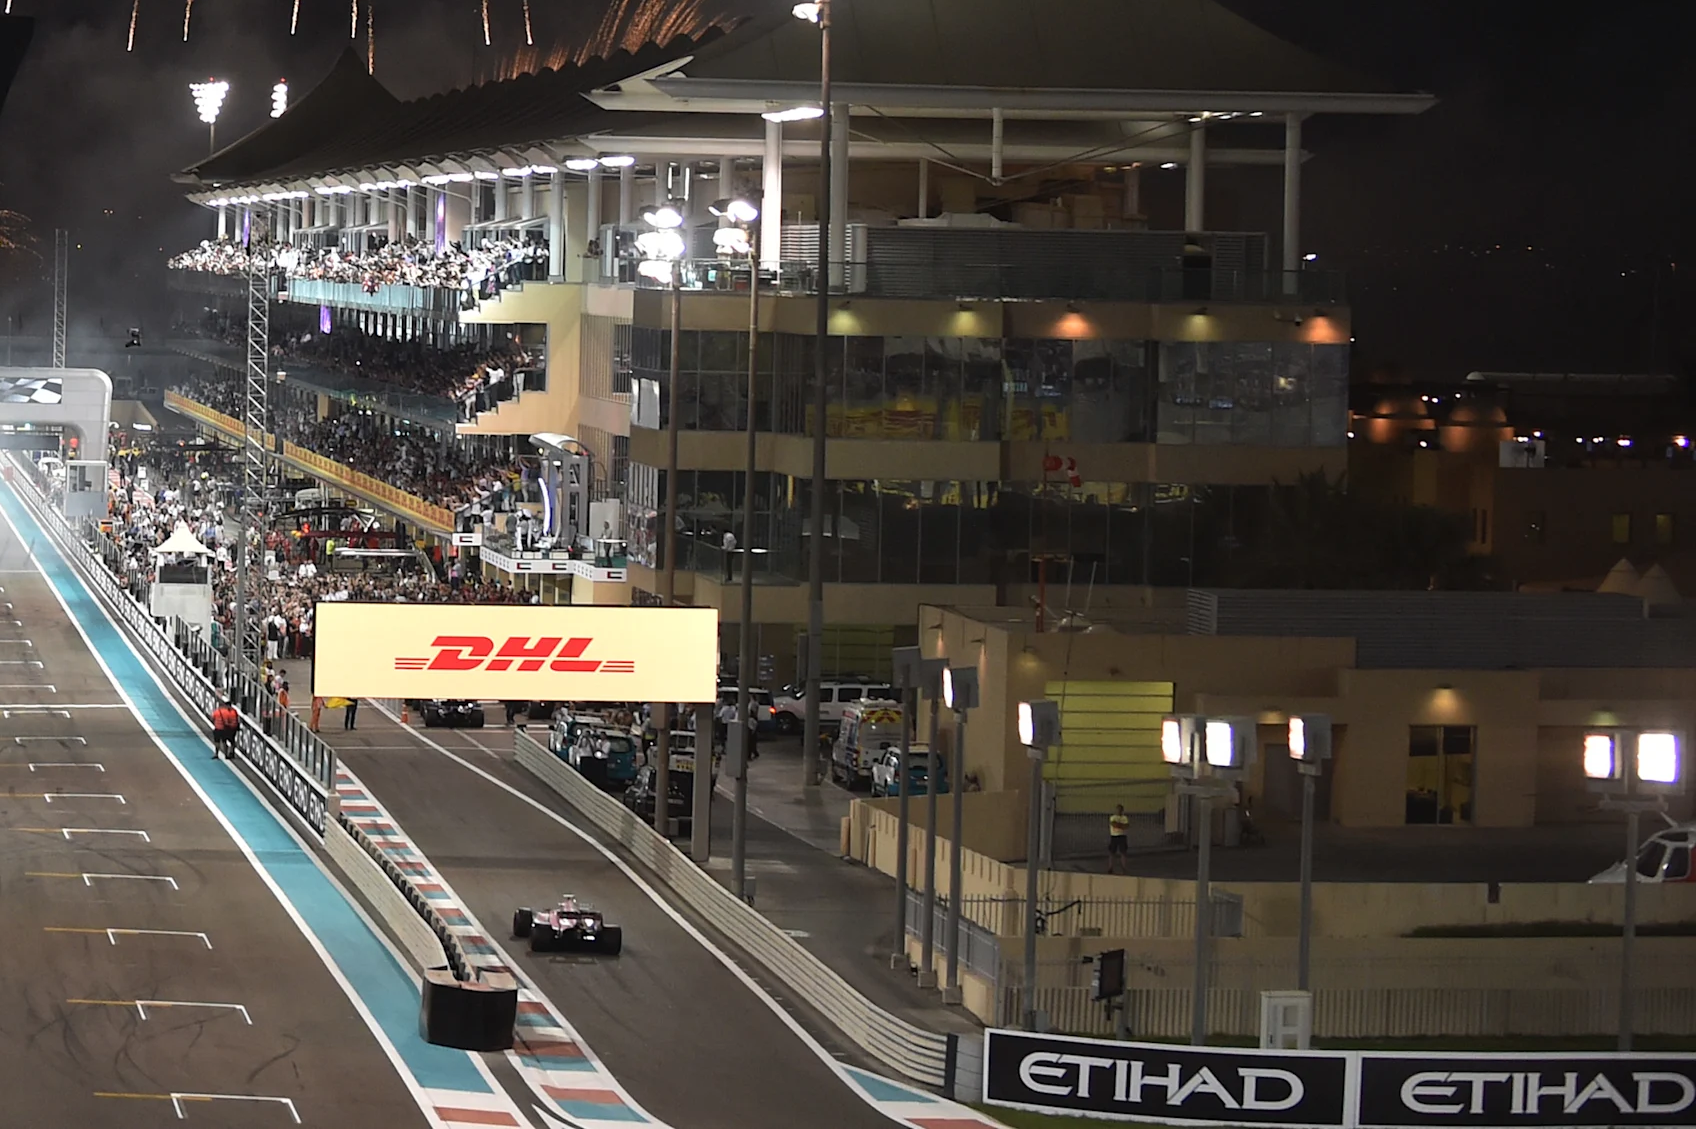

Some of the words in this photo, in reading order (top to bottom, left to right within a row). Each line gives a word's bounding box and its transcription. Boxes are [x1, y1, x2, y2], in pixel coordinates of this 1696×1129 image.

[426, 635, 603, 673] DHL
[1018, 1051, 1305, 1111] ETIHAD
[1399, 1071, 1696, 1114] ETIHAD
